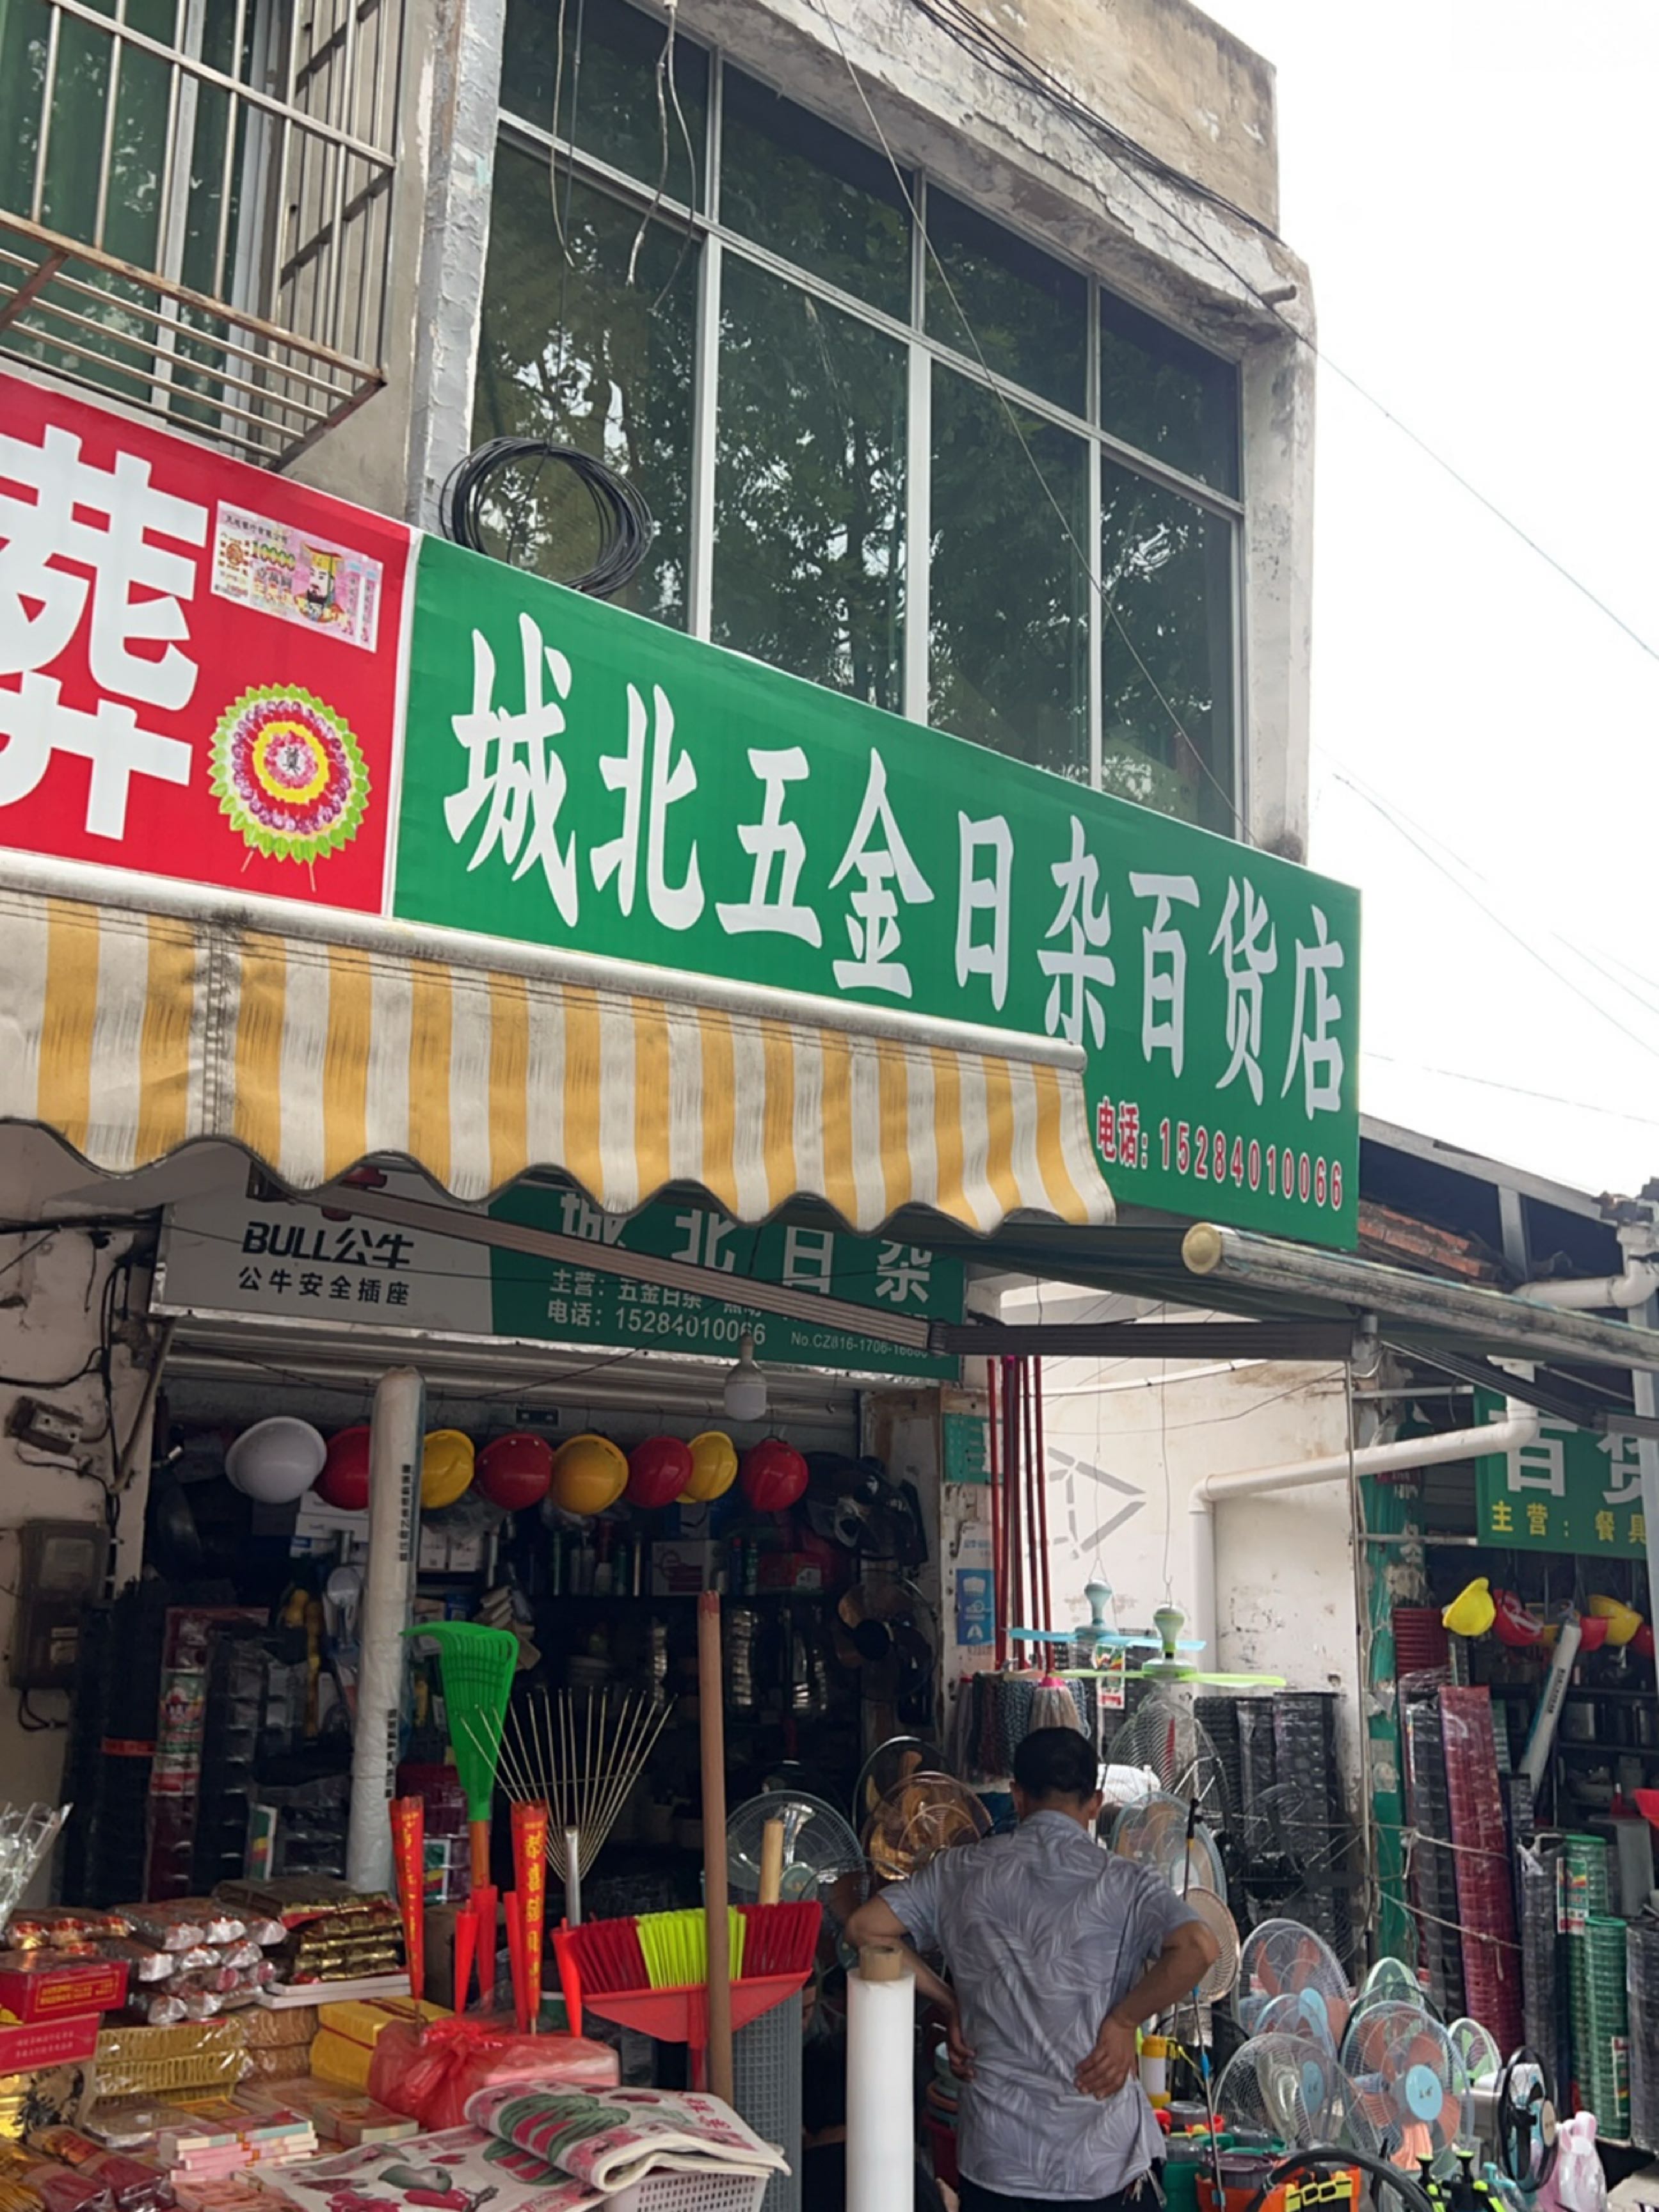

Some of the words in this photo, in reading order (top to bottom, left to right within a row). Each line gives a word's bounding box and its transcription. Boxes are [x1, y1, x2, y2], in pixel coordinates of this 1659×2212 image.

[444, 612, 1345, 1119] 城北五金日杂百货店
[242, 1221, 414, 1269] BULL公牛
[239, 1266, 410, 1306] 公牛安全插座
